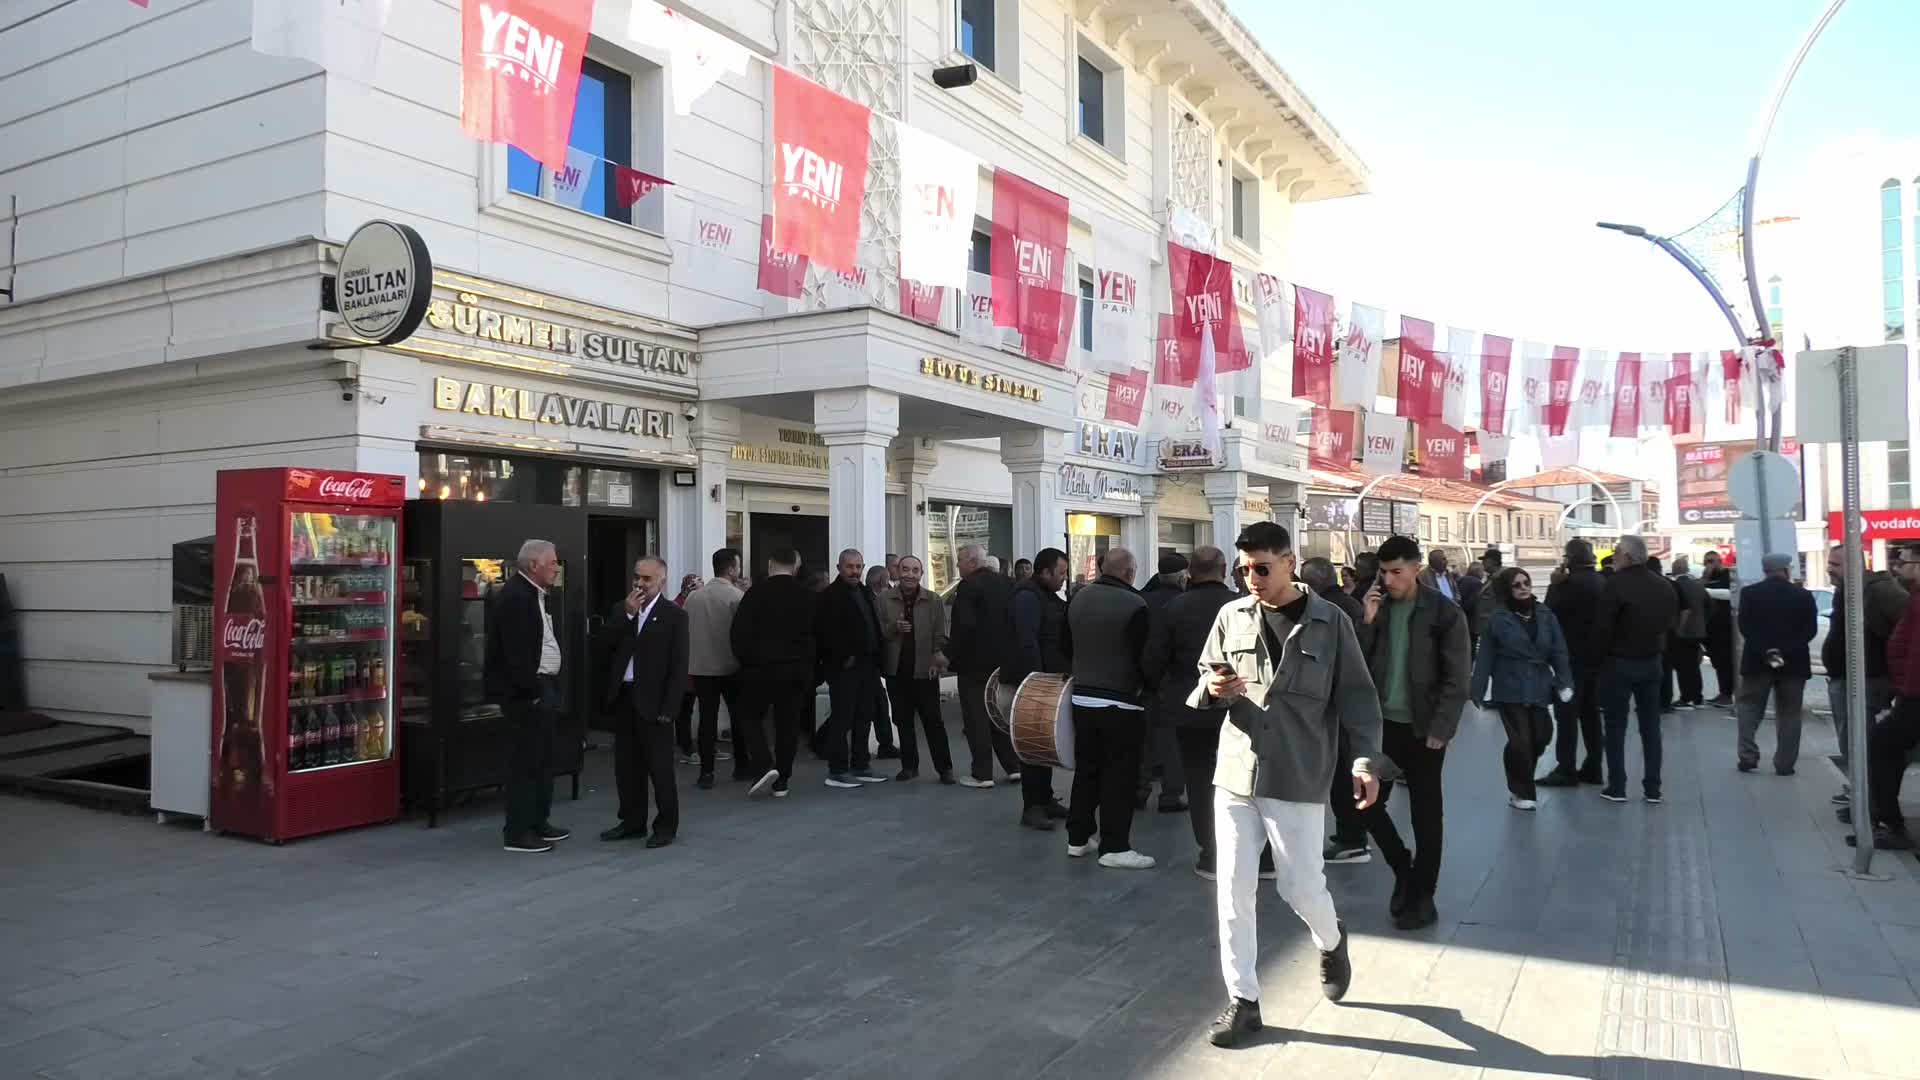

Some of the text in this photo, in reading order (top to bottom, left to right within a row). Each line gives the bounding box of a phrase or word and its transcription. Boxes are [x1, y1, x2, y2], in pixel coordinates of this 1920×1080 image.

[344, 268, 406, 297] SULTAN
[344, 289, 408, 311] BAKLAVALARI
[583, 332, 689, 375] SULTAN
[434, 376, 674, 438] BAKLAVALARI
[1081, 423, 1139, 461] ERAY
